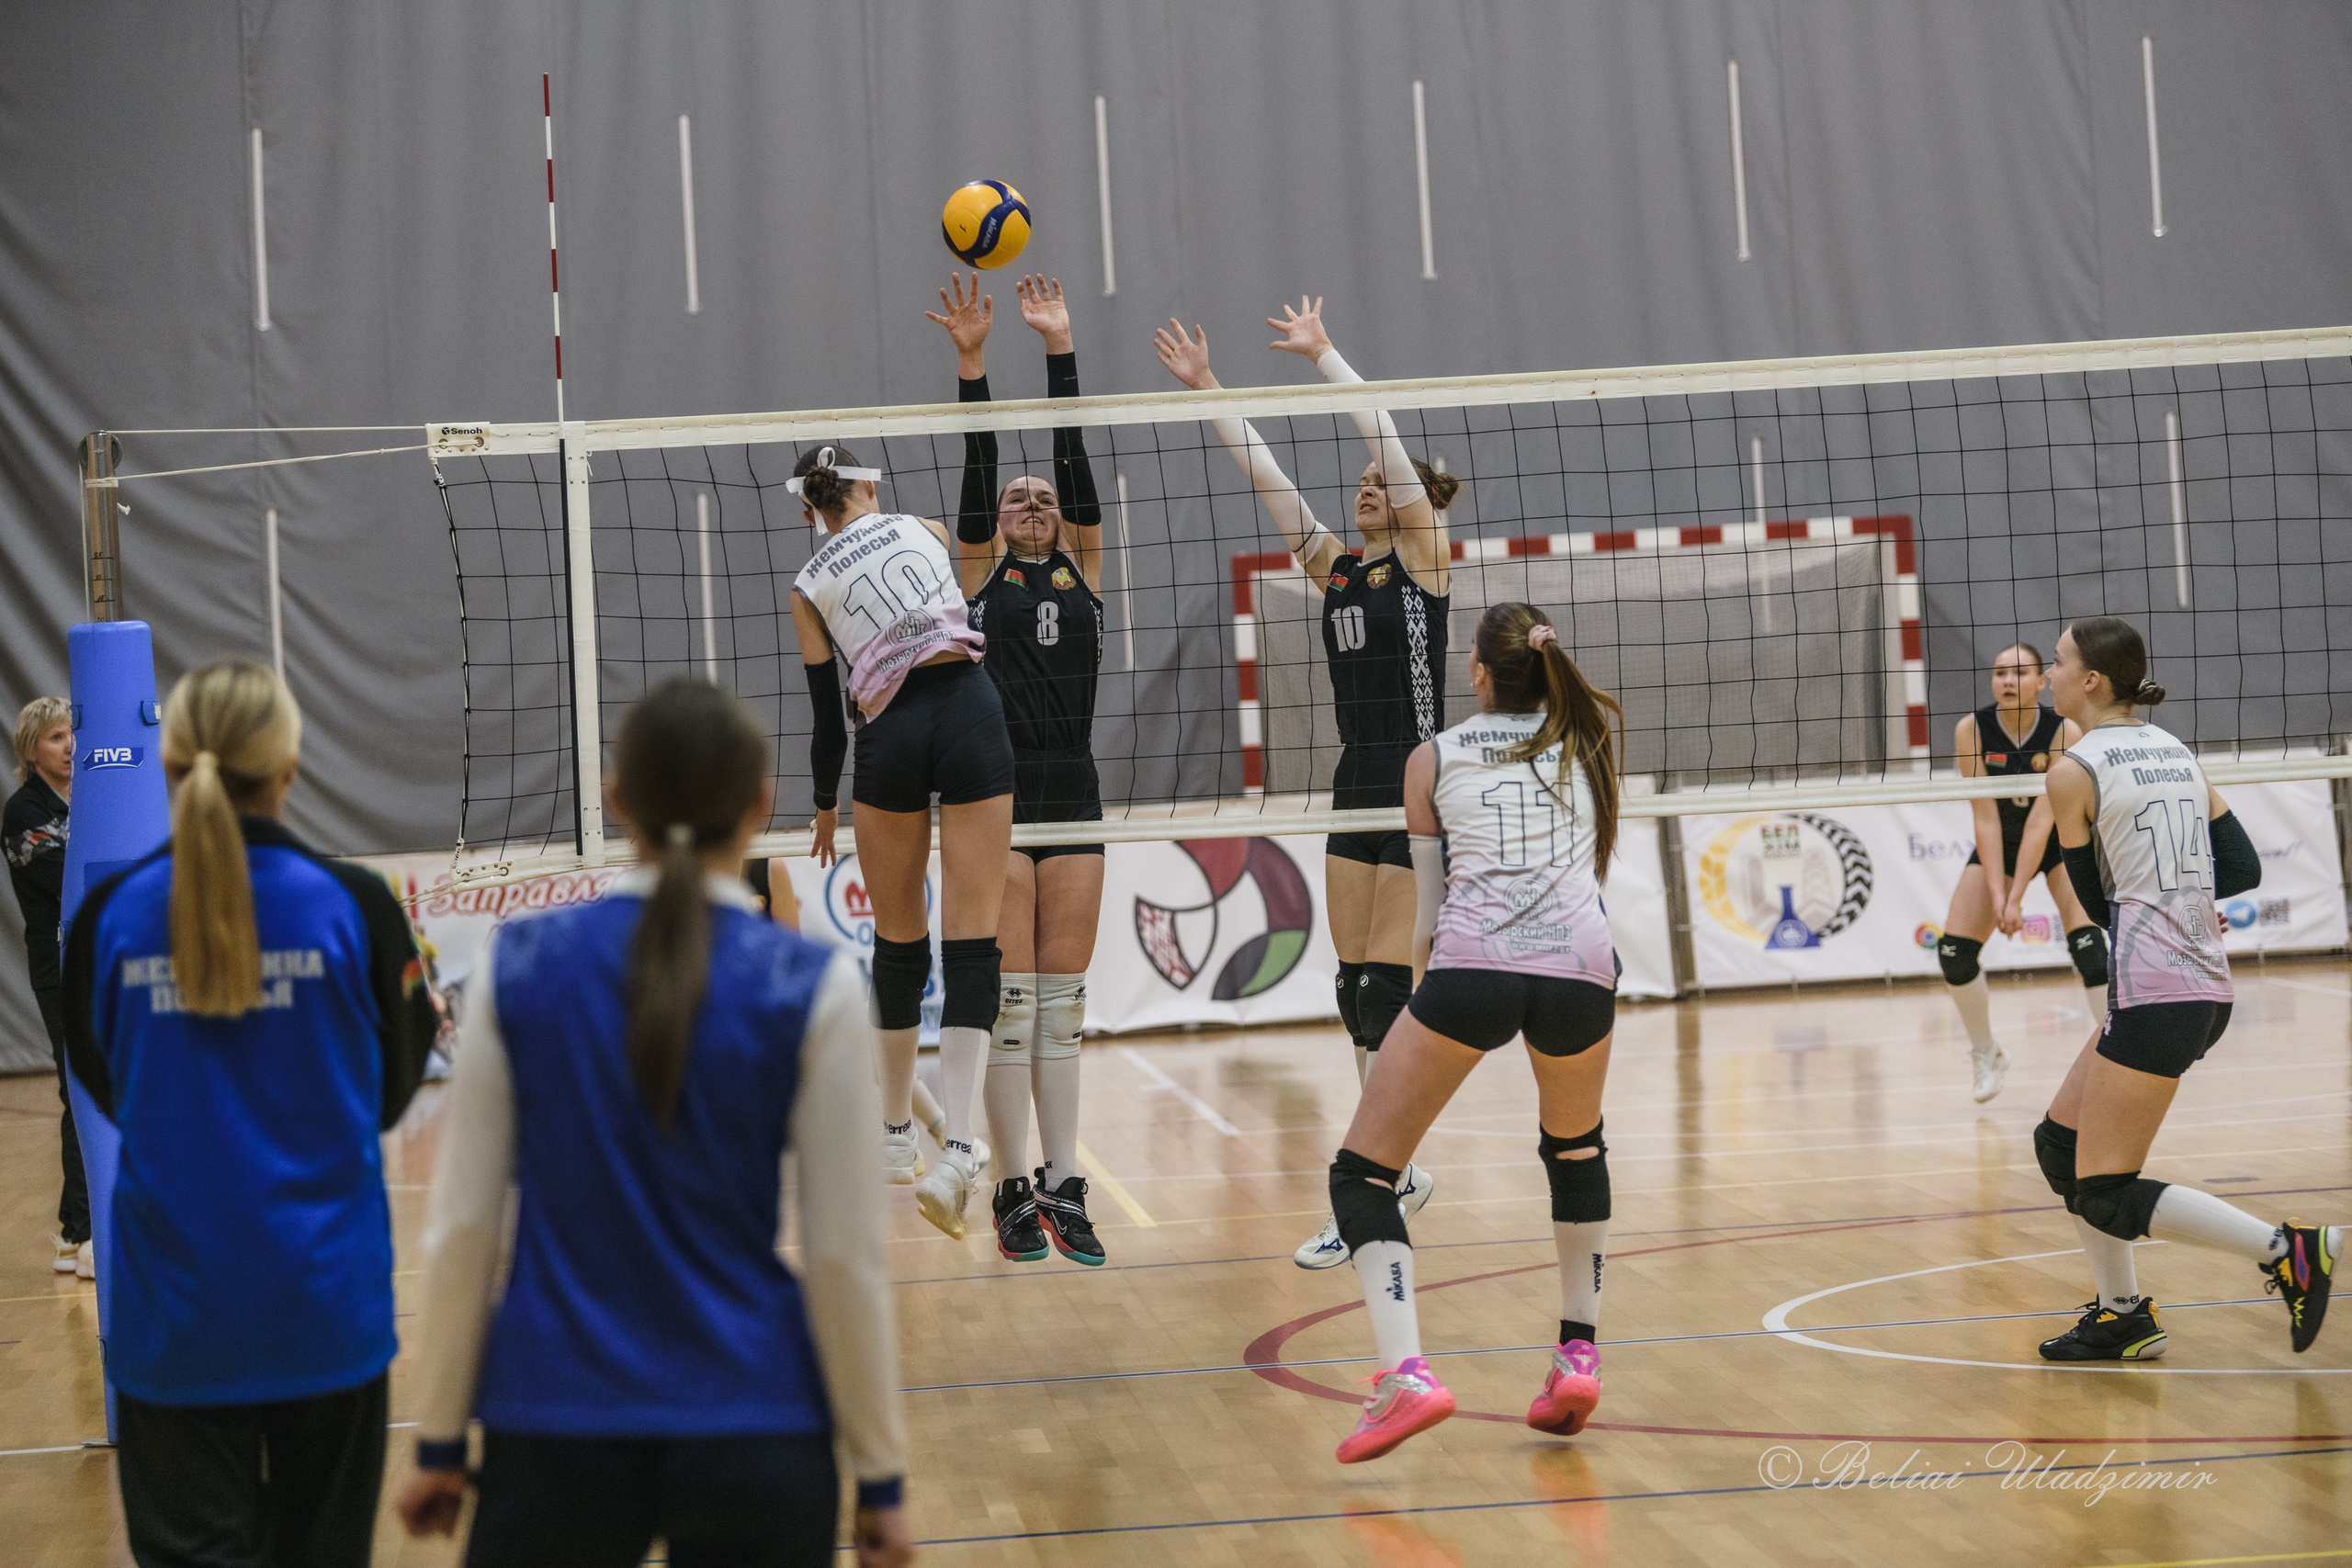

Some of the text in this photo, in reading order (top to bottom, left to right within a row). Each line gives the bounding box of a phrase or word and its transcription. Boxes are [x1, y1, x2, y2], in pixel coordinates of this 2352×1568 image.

[828, 528, 901, 579] Полесья
[842, 549, 944, 632] 10
[1036, 601, 1059, 646] 8
[1330, 605, 1366, 652] 10
[94, 747, 132, 763] FIVB
[2132, 767, 2194, 786] Полесья
[1482, 782, 1575, 868] 11
[2134, 799, 2213, 892] 14
[1546, 923, 1572, 942] НПЗ
